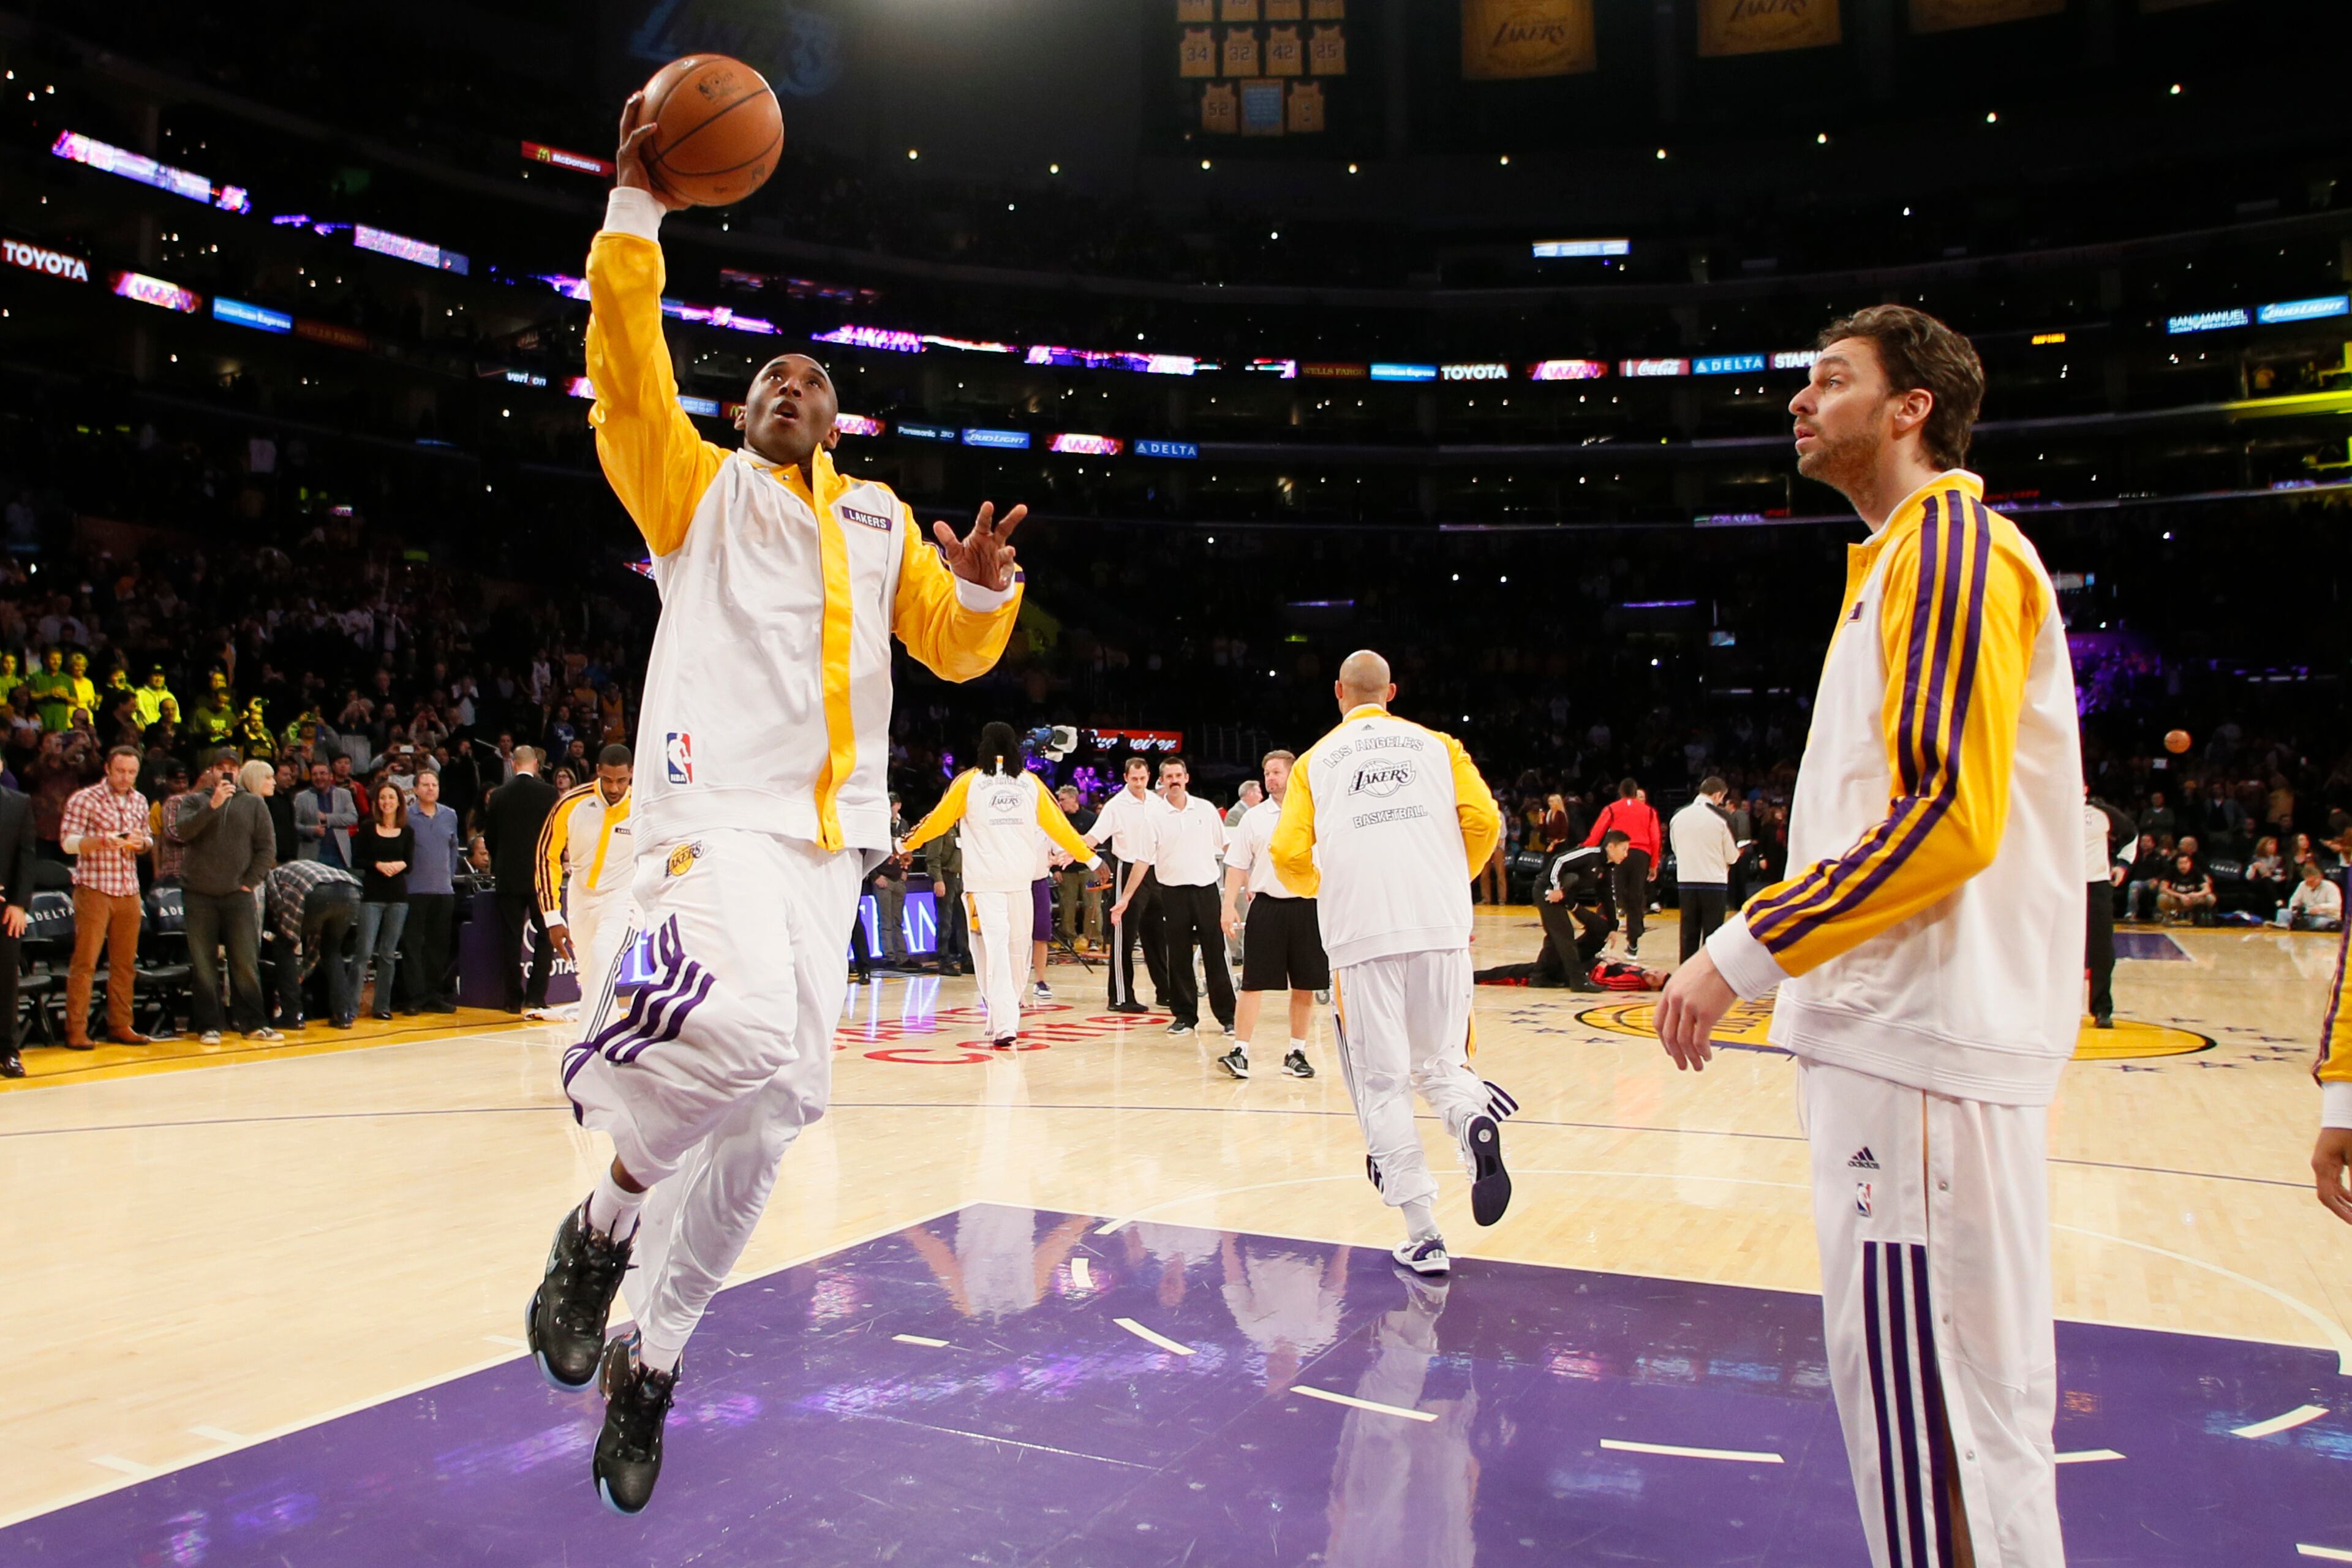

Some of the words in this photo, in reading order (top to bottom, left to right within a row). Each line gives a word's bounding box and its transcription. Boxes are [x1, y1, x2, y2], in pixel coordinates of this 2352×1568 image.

[552, 153, 601, 172] McDonald's
[2, 239, 89, 282] TOYOTA
[2169, 316, 2193, 329] SAN
[2199, 308, 2248, 325] MANUEL
[1711, 356, 1763, 371] DELTA
[1774, 350, 1822, 369] STAPL
[1302, 367, 1334, 376] WELLS
[1335, 367, 1366, 377] FARGO
[1440, 364, 1509, 380] TOYOTA
[897, 426, 936, 438] Panasonic
[994, 435, 1025, 444] LIGHT
[1151, 443, 1197, 456] DELTA
[848, 510, 888, 529] LAKERS
[1322, 744, 1353, 769] LOS
[1354, 736, 1424, 752] ANGELES
[670, 774, 686, 782] NBA
[1354, 767, 1410, 791] LAKERS
[1352, 805, 1428, 829] BASKETBALL
[665, 845, 701, 878] LAKERS
[34, 906, 75, 921] DELTA
[1847, 1160, 1881, 1170] adidas
